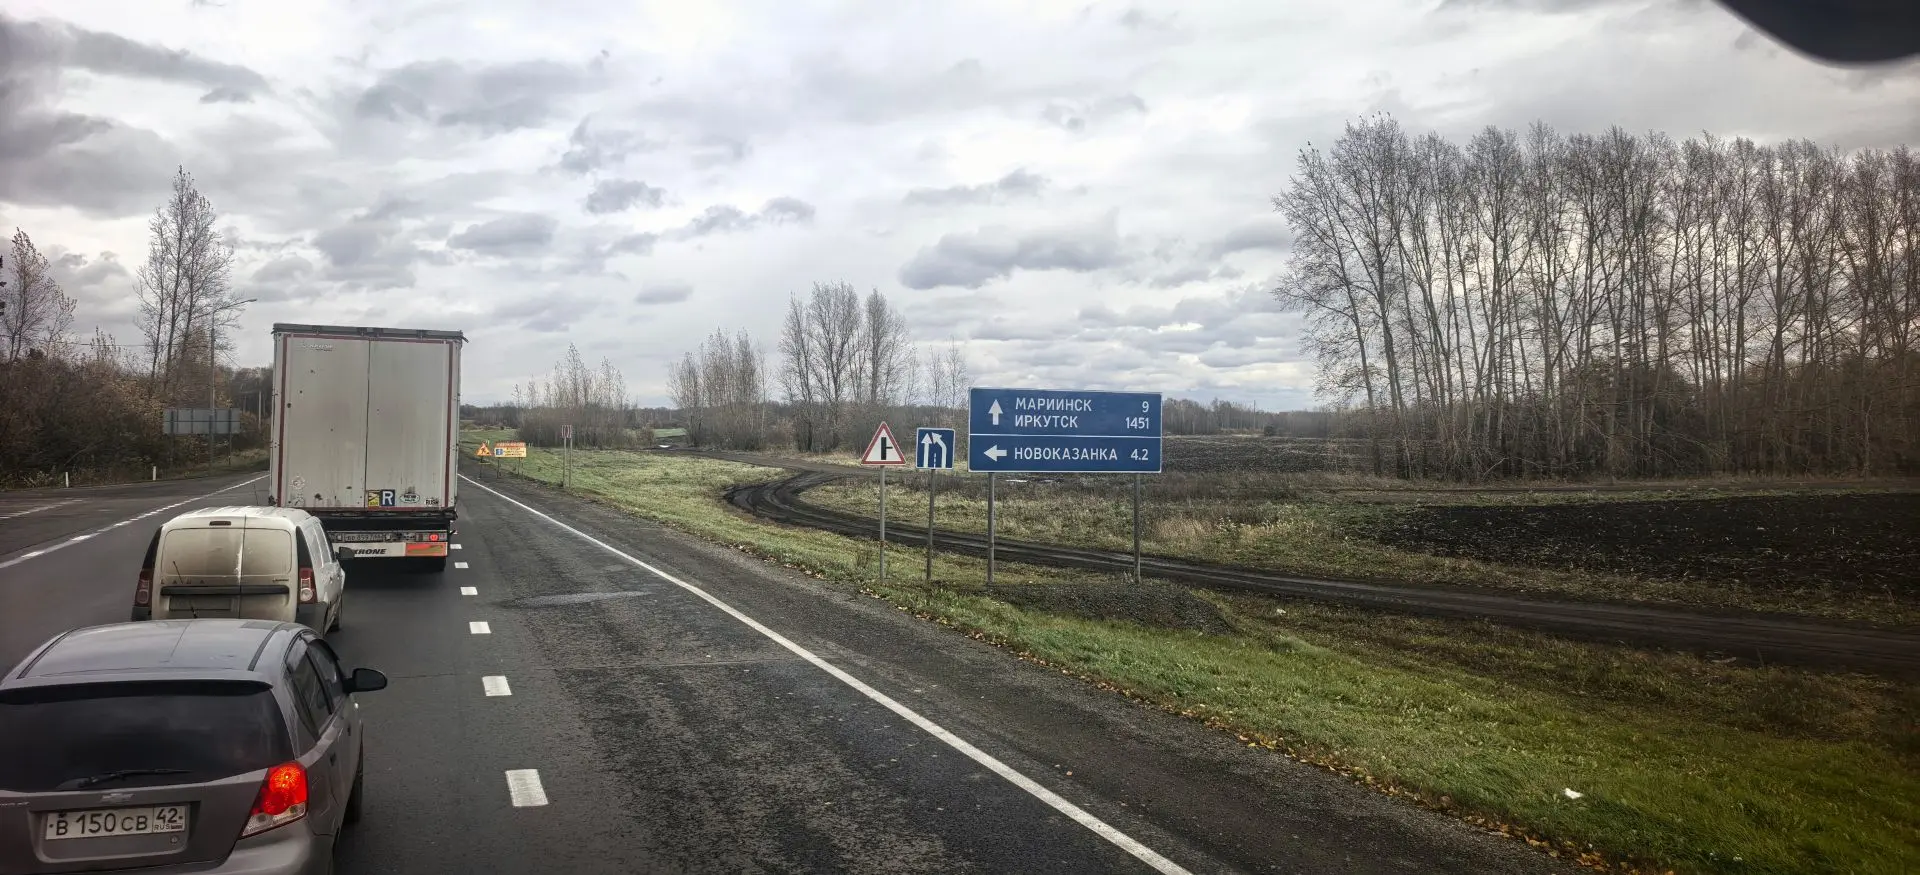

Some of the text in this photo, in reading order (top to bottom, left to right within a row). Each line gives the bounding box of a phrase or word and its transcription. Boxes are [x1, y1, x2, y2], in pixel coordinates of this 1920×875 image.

[1015, 397, 1150, 413] МАРИИНСК 9
[1015, 415, 1150, 430] ИРКУТСК 1451
[1014, 447, 1149, 461] НОВОКАЗАНКА 4.2
[382, 490, 394, 505] R
[156, 806, 178, 824] 42
[75, 812, 116, 835] 150
[121, 814, 148, 832] СВ
[153, 823, 170, 831] RUS
